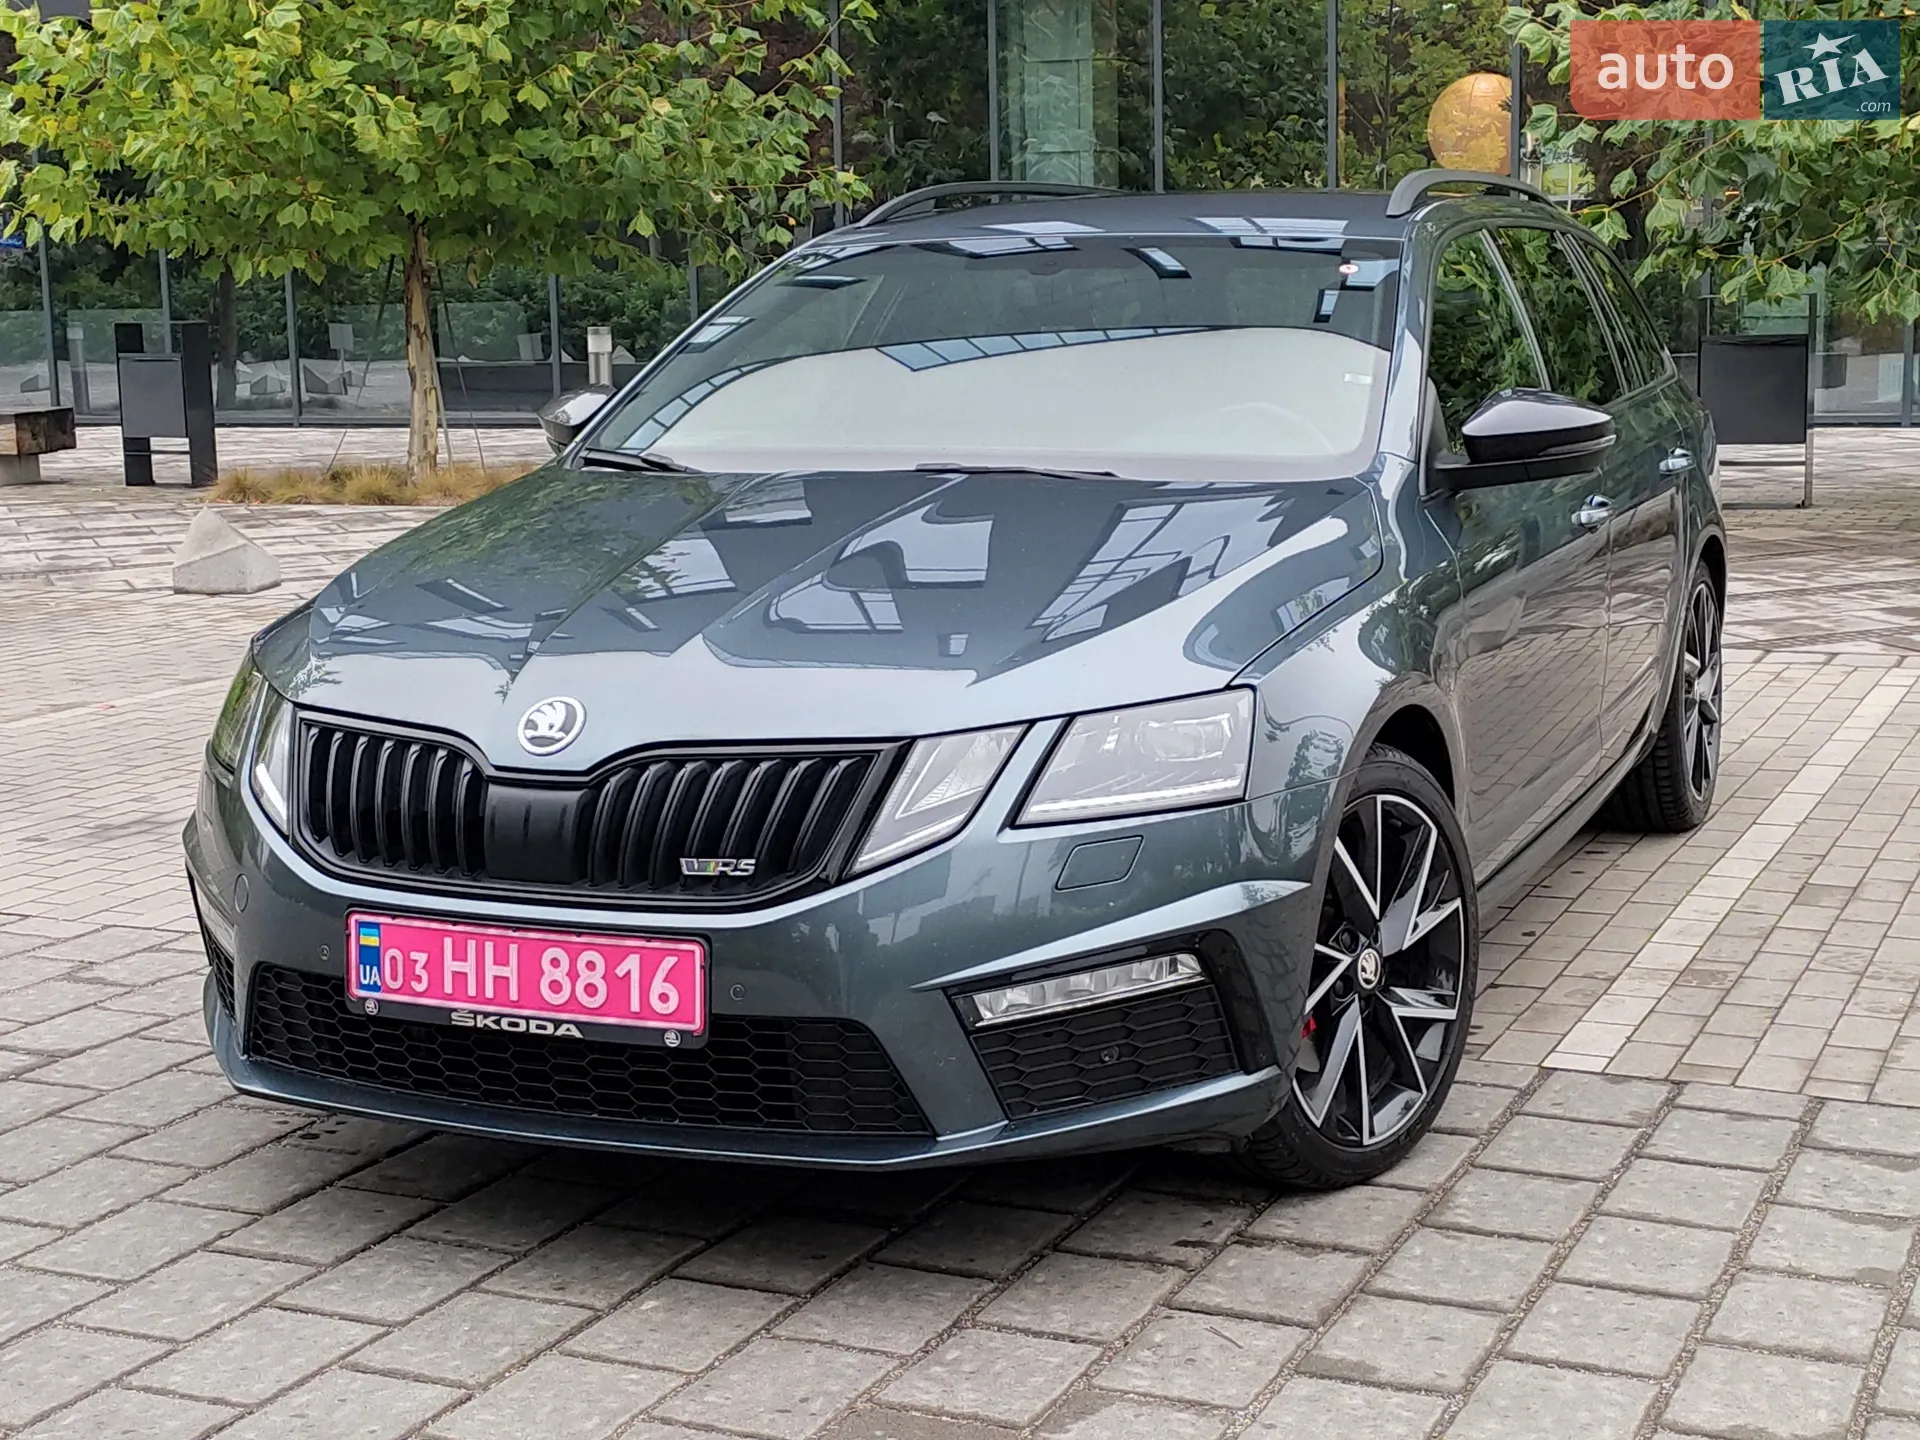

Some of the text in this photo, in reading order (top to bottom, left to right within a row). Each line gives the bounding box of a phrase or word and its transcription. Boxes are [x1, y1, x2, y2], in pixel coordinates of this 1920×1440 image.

[359, 965, 382, 987] UA
[384, 936, 680, 1016] 03 HH 8816
[451, 1009, 584, 1039] ŠKODA
